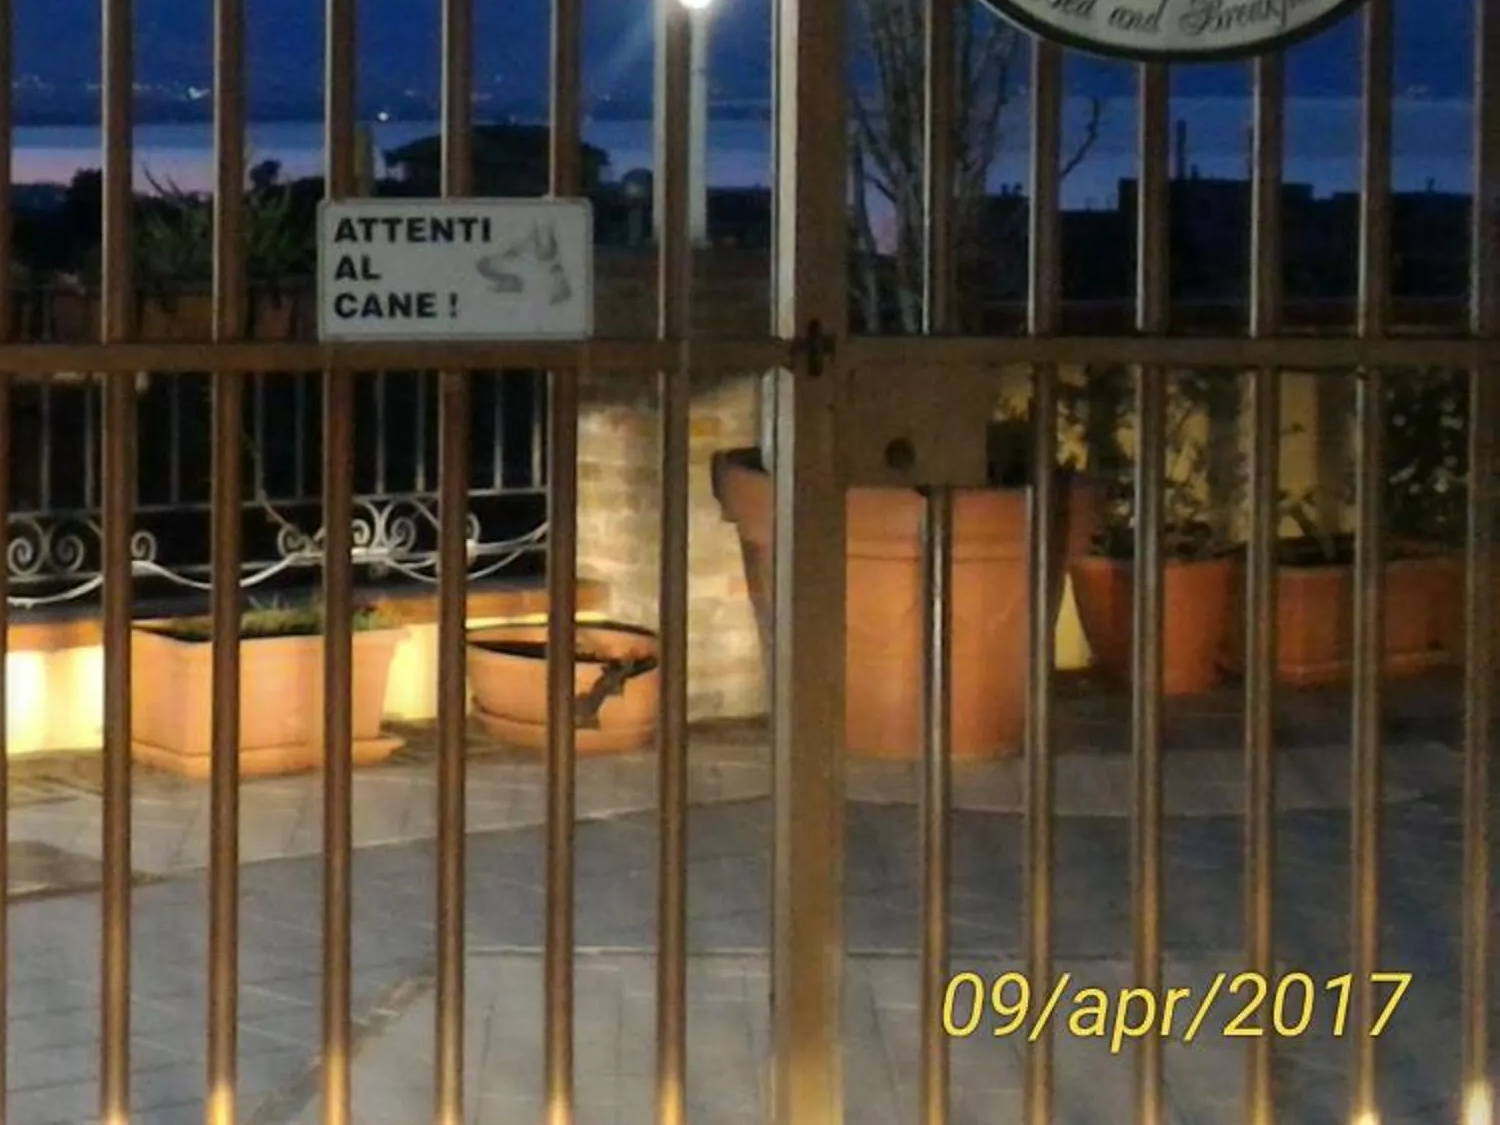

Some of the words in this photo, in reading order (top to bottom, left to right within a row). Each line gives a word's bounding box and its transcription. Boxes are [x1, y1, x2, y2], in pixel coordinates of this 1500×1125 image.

[333, 216, 492, 243] ATTENTI
[333, 254, 382, 281] AL
[333, 292, 438, 319] CANE
